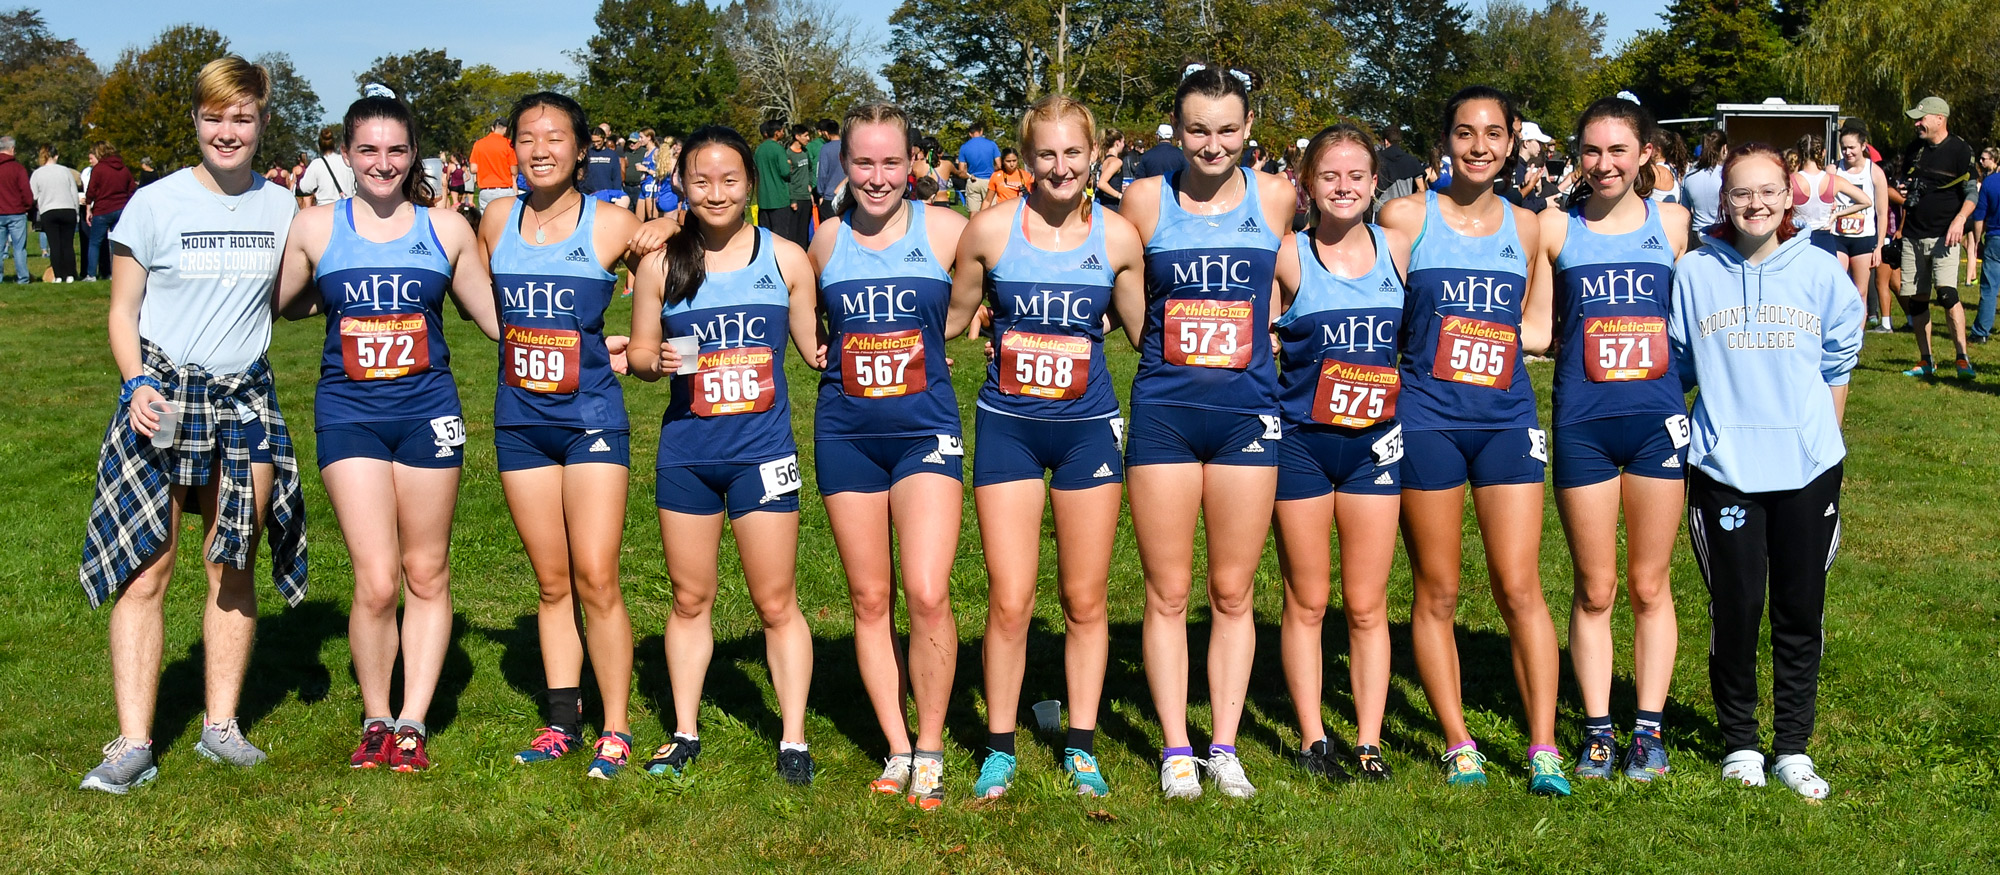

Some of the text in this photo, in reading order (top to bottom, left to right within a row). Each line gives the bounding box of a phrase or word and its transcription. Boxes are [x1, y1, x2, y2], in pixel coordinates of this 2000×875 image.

[1841, 218, 1860, 231] 874
[181, 236, 276, 250] MOUNT HOLYOKE
[409, 248, 432, 256] adidas
[565, 255, 589, 263] adidas
[903, 255, 927, 263] adidas
[1500, 252, 1518, 260] adidas
[179, 251, 221, 272] CROSS
[1080, 263, 1103, 271] adidas
[1172, 254, 1251, 292] MHC
[343, 274, 422, 311] MHC
[503, 281, 575, 319] MHC
[841, 285, 917, 323] MHC
[1441, 276, 1513, 313] MHC
[1580, 268, 1655, 305] MHC
[1013, 290, 1092, 327] MHC
[1699, 304, 1822, 339] MOUNT HOLYOKE
[690, 312, 766, 349] MHC
[1180, 321, 1237, 355] 573
[1321, 315, 1394, 353] MHC
[1727, 331, 1796, 350] COLLEGE
[357, 335, 415, 368] 572
[514, 347, 565, 382] 569
[1450, 338, 1506, 376] 565
[1599, 337, 1653, 368] 571
[703, 369, 760, 403] 566
[855, 352, 910, 387] 567
[1015, 352, 1074, 388] 568
[1329, 382, 1387, 419] 575
[1678, 414, 1689, 438] 5
